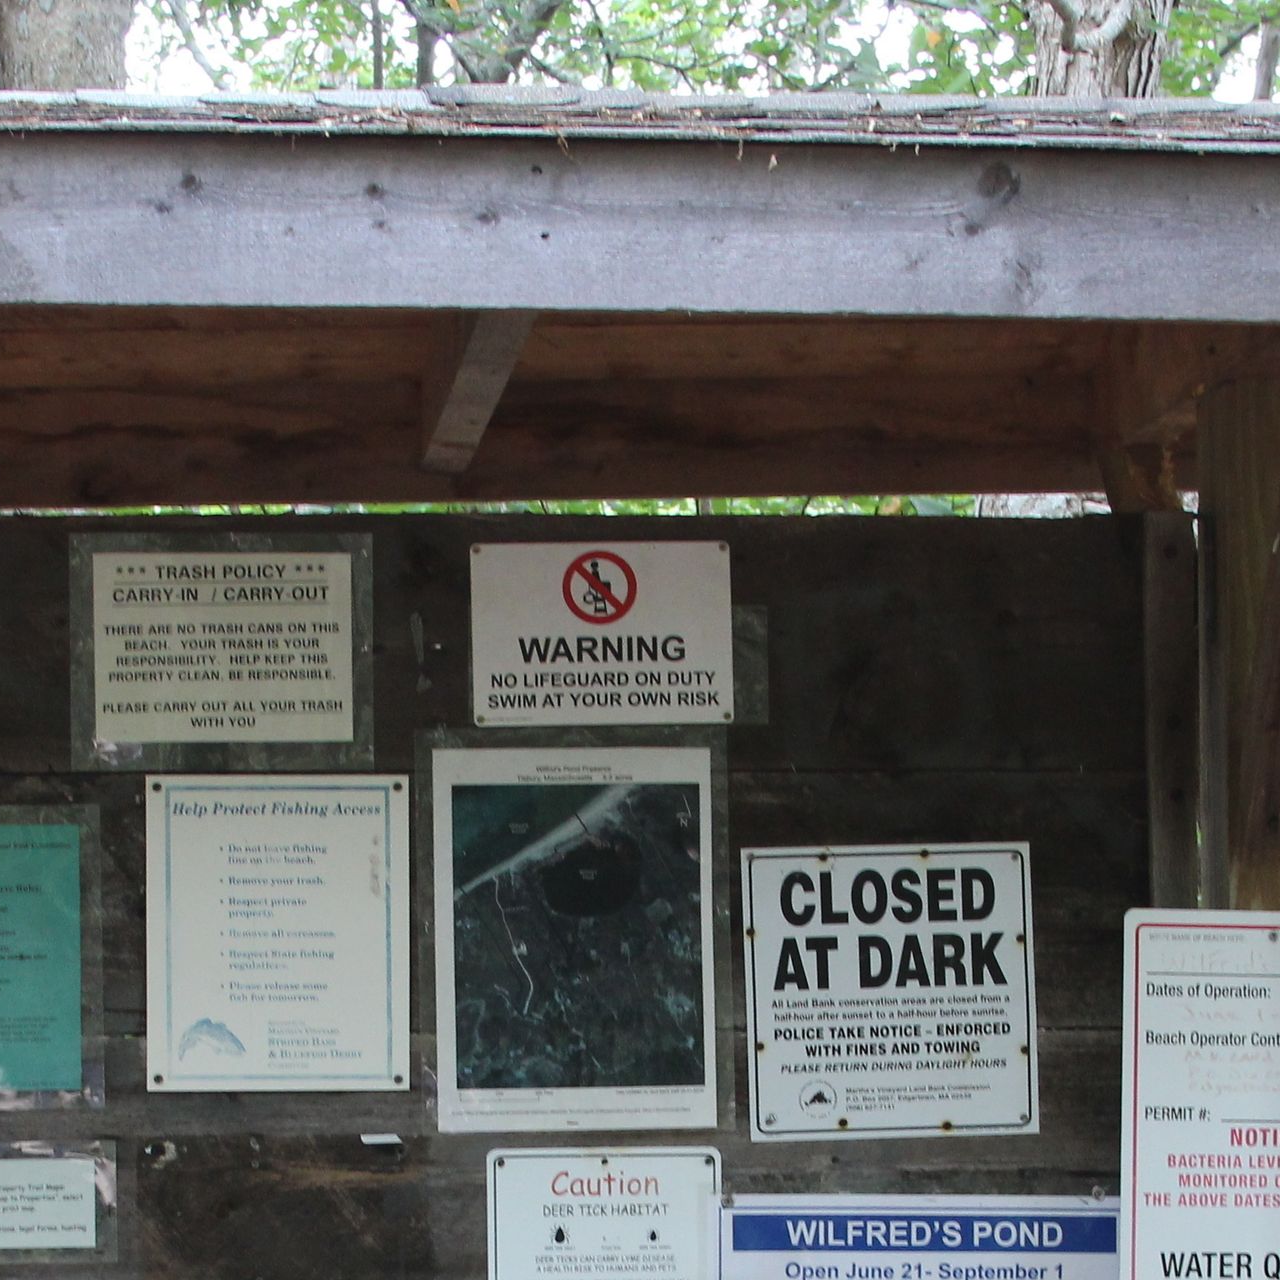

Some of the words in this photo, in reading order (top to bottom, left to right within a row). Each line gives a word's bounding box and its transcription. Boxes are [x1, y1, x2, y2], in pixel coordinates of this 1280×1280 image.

[156, 565, 215, 579] TRASH
[223, 565, 285, 579] POLICY
[113, 588, 198, 602] CARRY-IN
[224, 586, 328, 601] CARRY-OUT
[105, 625, 143, 635] THERE
[149, 625, 171, 635] ARE
[177, 624, 195, 634] NO
[202, 624, 243, 634] TRASH
[248, 623, 283, 634] CANS
[288, 623, 306, 633] ON
[312, 623, 339, 632] THIS
[181, 639, 216, 649] YOUR
[222, 639, 263, 649] TRASH
[268, 639, 278, 649] IS
[284, 638, 319, 648] YOUR
[518, 635, 685, 663] WARNING
[230, 655, 260, 664] HELP
[265, 654, 295, 664] KEEP
[301, 654, 328, 664] THIS
[109, 671, 172, 682] PROPERTY
[229, 670, 242, 680] BE
[491, 674, 517, 688] NO
[524, 672, 629, 687] LIFEGUARD
[635, 672, 661, 686] ON
[668, 671, 715, 685] DUTY
[103, 703, 148, 713] PLEASE
[154, 702, 196, 712] CARRY
[202, 702, 226, 712] OUT
[234, 702, 253, 711] ALL
[261, 701, 296, 712] YOUR
[301, 700, 342, 712] TRASH
[489, 694, 536, 708] SWIM
[542, 693, 564, 708] AT
[570, 693, 621, 707] YOUR
[628, 692, 671, 706] OWN
[678, 692, 719, 706] RISK
[191, 717, 223, 727] WITH
[229, 717, 255, 727] YOU
[173, 802, 207, 818] Help
[213, 802, 266, 815] Protect
[272, 802, 328, 817] Fishing
[333, 803, 380, 815] Access
[780, 868, 995, 926] CLOSED
[774, 936, 838, 991] AT
[858, 932, 1007, 988] DARK
[1147, 983, 1183, 996] Dates
[1188, 984, 1200, 997] of
[1205, 984, 1270, 999] Operation:
[772, 1000, 783, 1008] All
[787, 1000, 808, 1008] Land
[812, 998, 835, 1008] Bank
[839, 997, 898, 1007] conservation
[948, 995, 977, 1004] closed
[981, 994, 1001, 1003] from
[1004, 995, 1010, 1003] a
[774, 1012, 813, 1021] half-hour
[817, 1011, 838, 1020] after
[842, 1012, 872, 1020] sunset
[876, 1011, 886, 1019] to
[897, 1009, 936, 1018] half-hour
[940, 1008, 968, 1017] before
[774, 1028, 823, 1040] POLICE
[829, 1027, 864, 1039] TAKE
[870, 1025, 921, 1038] NOTICE
[937, 1023, 1010, 1036] ENFORCED
[1146, 1031, 1185, 1044] Beach
[1191, 1031, 1246, 1049] Operator
[806, 1045, 841, 1057] WITH
[846, 1043, 886, 1056] FINES
[892, 1043, 920, 1054] AND
[925, 1041, 980, 1054] TOWING
[781, 1064, 820, 1074] PLEASE
[825, 1062, 868, 1072] RETURN
[872, 1061, 912, 1071] DURING
[916, 1059, 967, 1070] DAYLIGHT
[968, 1057, 1006, 1068] HOURS
[1145, 1107, 1195, 1120] PERMIT
[1168, 1154, 1242, 1168] BACTERIA
[551, 1171, 658, 1196] Caution
[1179, 1174, 1267, 1188] MONITORED
[1144, 1193, 1170, 1206] THE
[1178, 1193, 1227, 1207] ABOVE
[1234, 1194, 1280, 1208] DATES
[543, 1204, 574, 1217] DEER
[579, 1204, 607, 1216] TICK
[611, 1204, 667, 1216] HABITAT
[787, 1220, 961, 1247] WILFRED'S
[973, 1222, 1063, 1248] POND
[846, 1263, 894, 1279] June
[902, 1263, 931, 1279] 21-
[1056, 1264, 1062, 1279] 1
[1161, 1253, 1251, 1278] WATER
